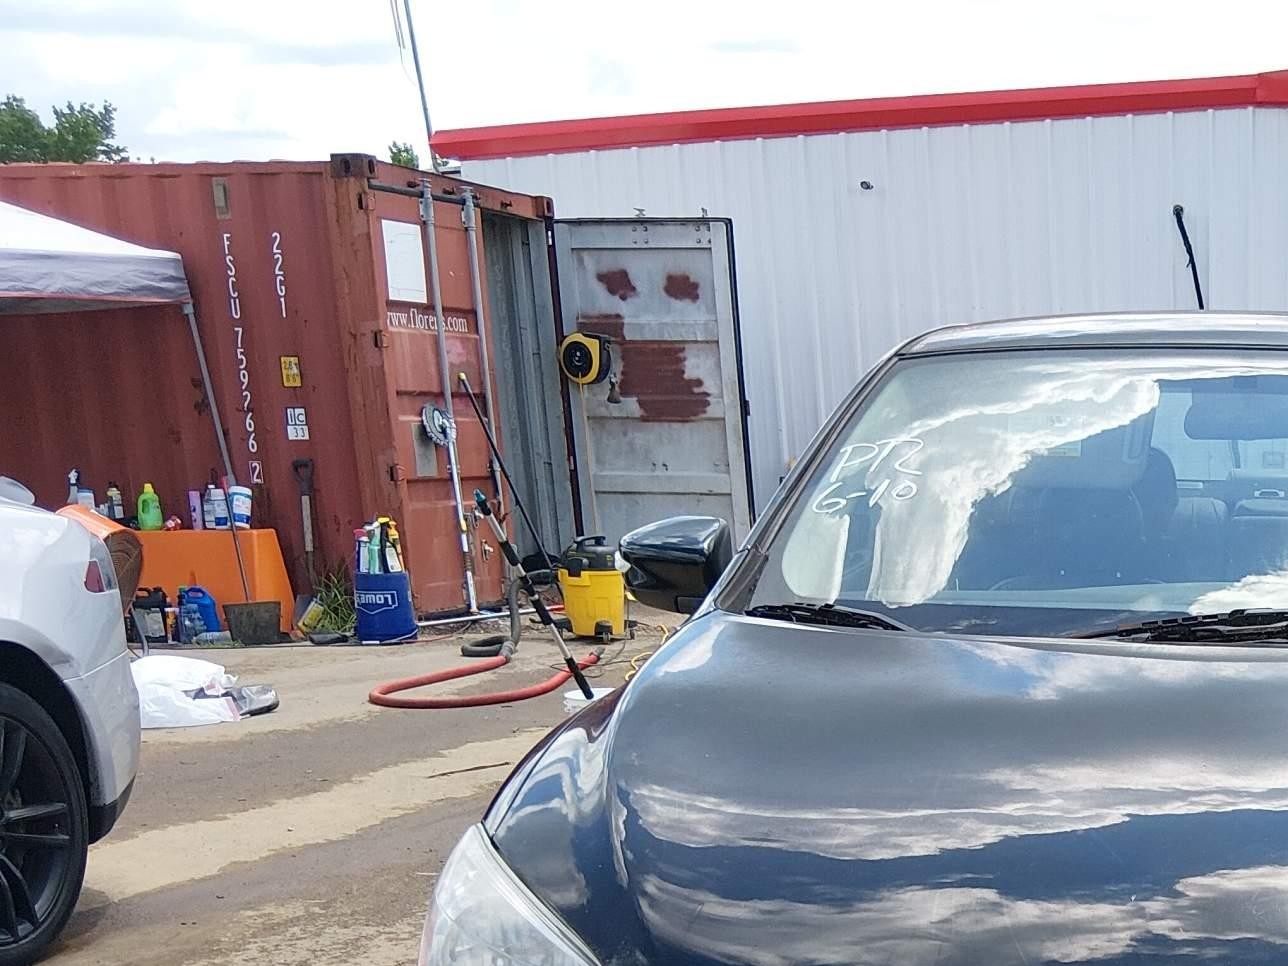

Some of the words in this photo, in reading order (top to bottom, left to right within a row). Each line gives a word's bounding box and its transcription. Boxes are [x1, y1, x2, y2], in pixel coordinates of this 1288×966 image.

[272, 232, 286, 318] 22G1
[223, 233, 240, 319] FSCU
[250, 462, 262, 483] 2
[812, 479, 917, 513] 6-10
